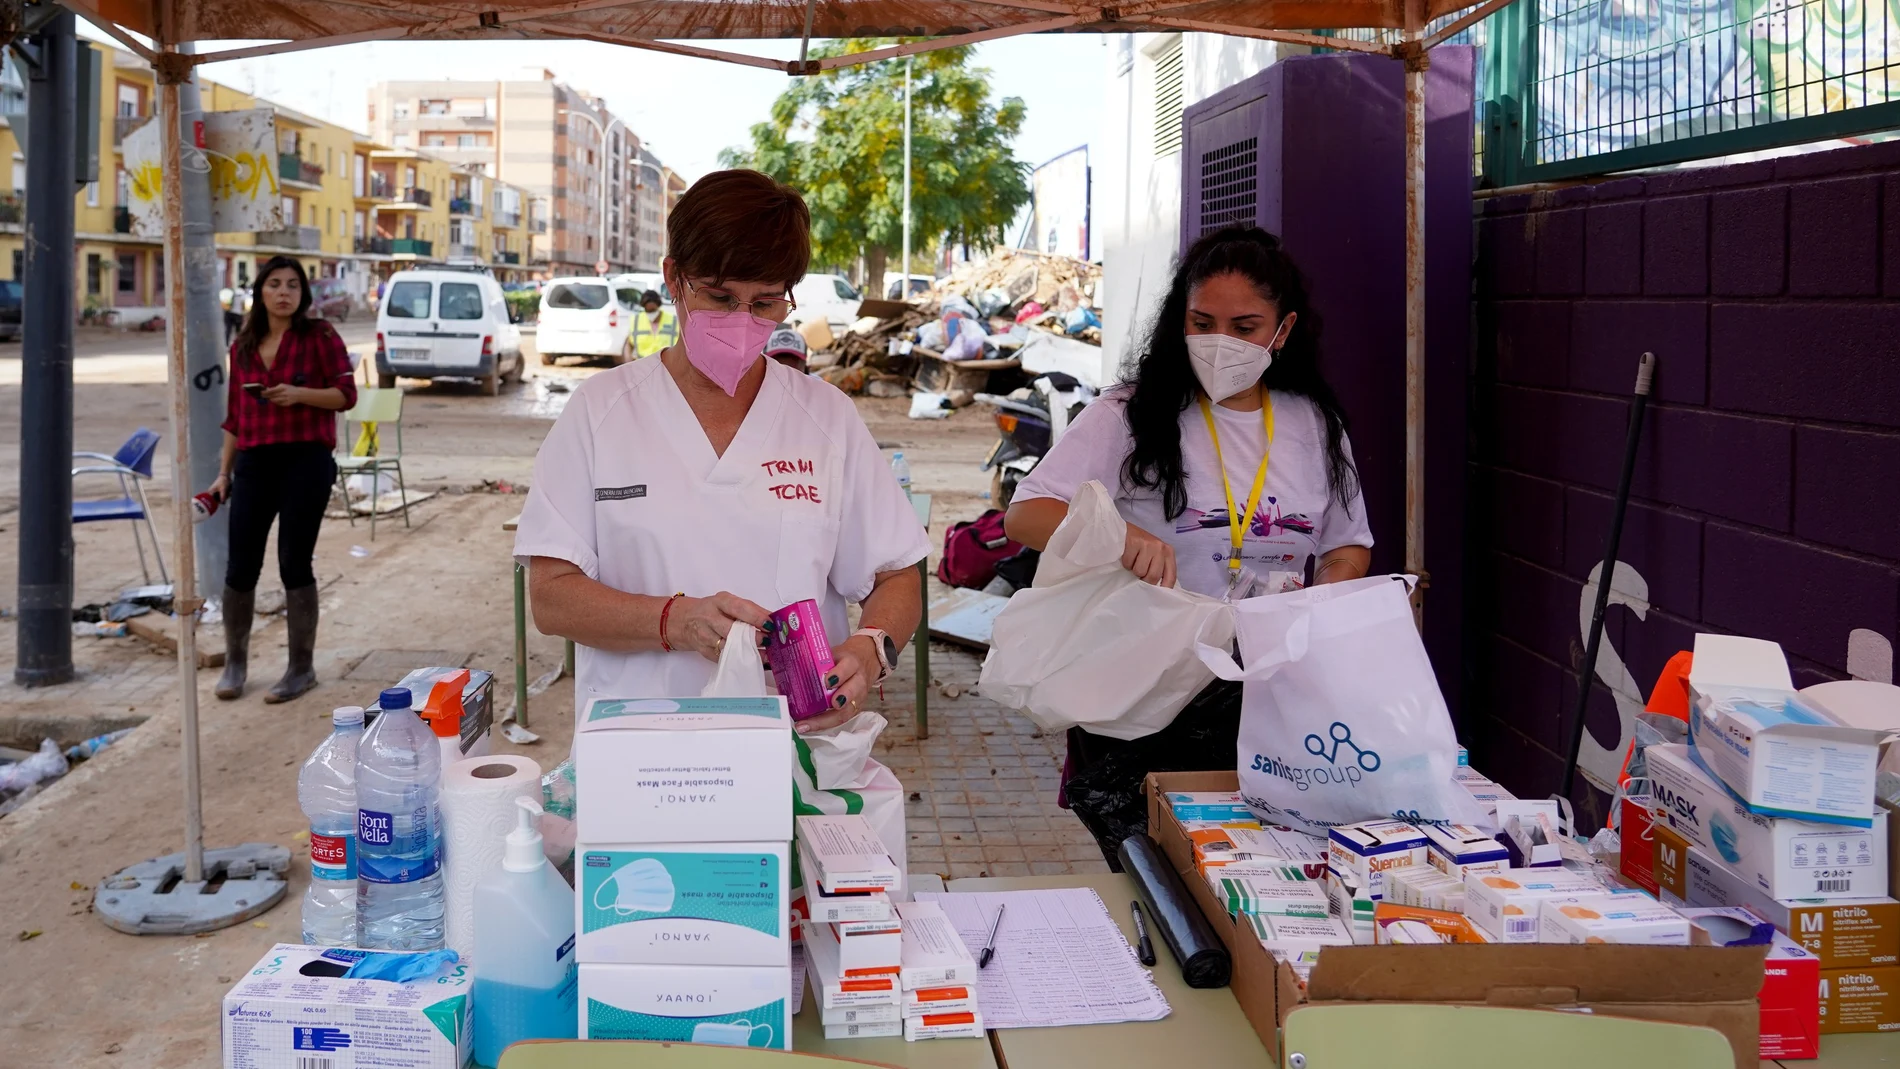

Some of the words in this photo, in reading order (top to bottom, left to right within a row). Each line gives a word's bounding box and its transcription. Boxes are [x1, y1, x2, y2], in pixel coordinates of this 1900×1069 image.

[769, 484, 822, 503] TCAE
[636, 780, 660, 788] Mask
[684, 779, 734, 787] Disposable
[659, 794, 717, 804] YAANQI
[1652, 779, 1699, 827] MASK
[360, 811, 389, 829] Font
[360, 825, 390, 843] Vella
[1330, 840, 1355, 864] Sueroral
[1661, 843, 1676, 869] M
[1369, 850, 1413, 873] Sueroral
[1663, 873, 1674, 885] 7-8
[728, 892, 774, 900] Disposable
[1800, 912, 1824, 932] M
[1832, 908, 1868, 918] nitrilo
[654, 933, 711, 941] YAANQI
[1803, 940, 1821, 949] 7-8
[267, 955, 288, 968] S
[252, 967, 281, 976] 6-7
[450, 965, 469, 977] S
[437, 976, 466, 986] 6-7
[1838, 974, 1874, 984] nitrilo
[656, 994, 713, 1003] YAANQI
